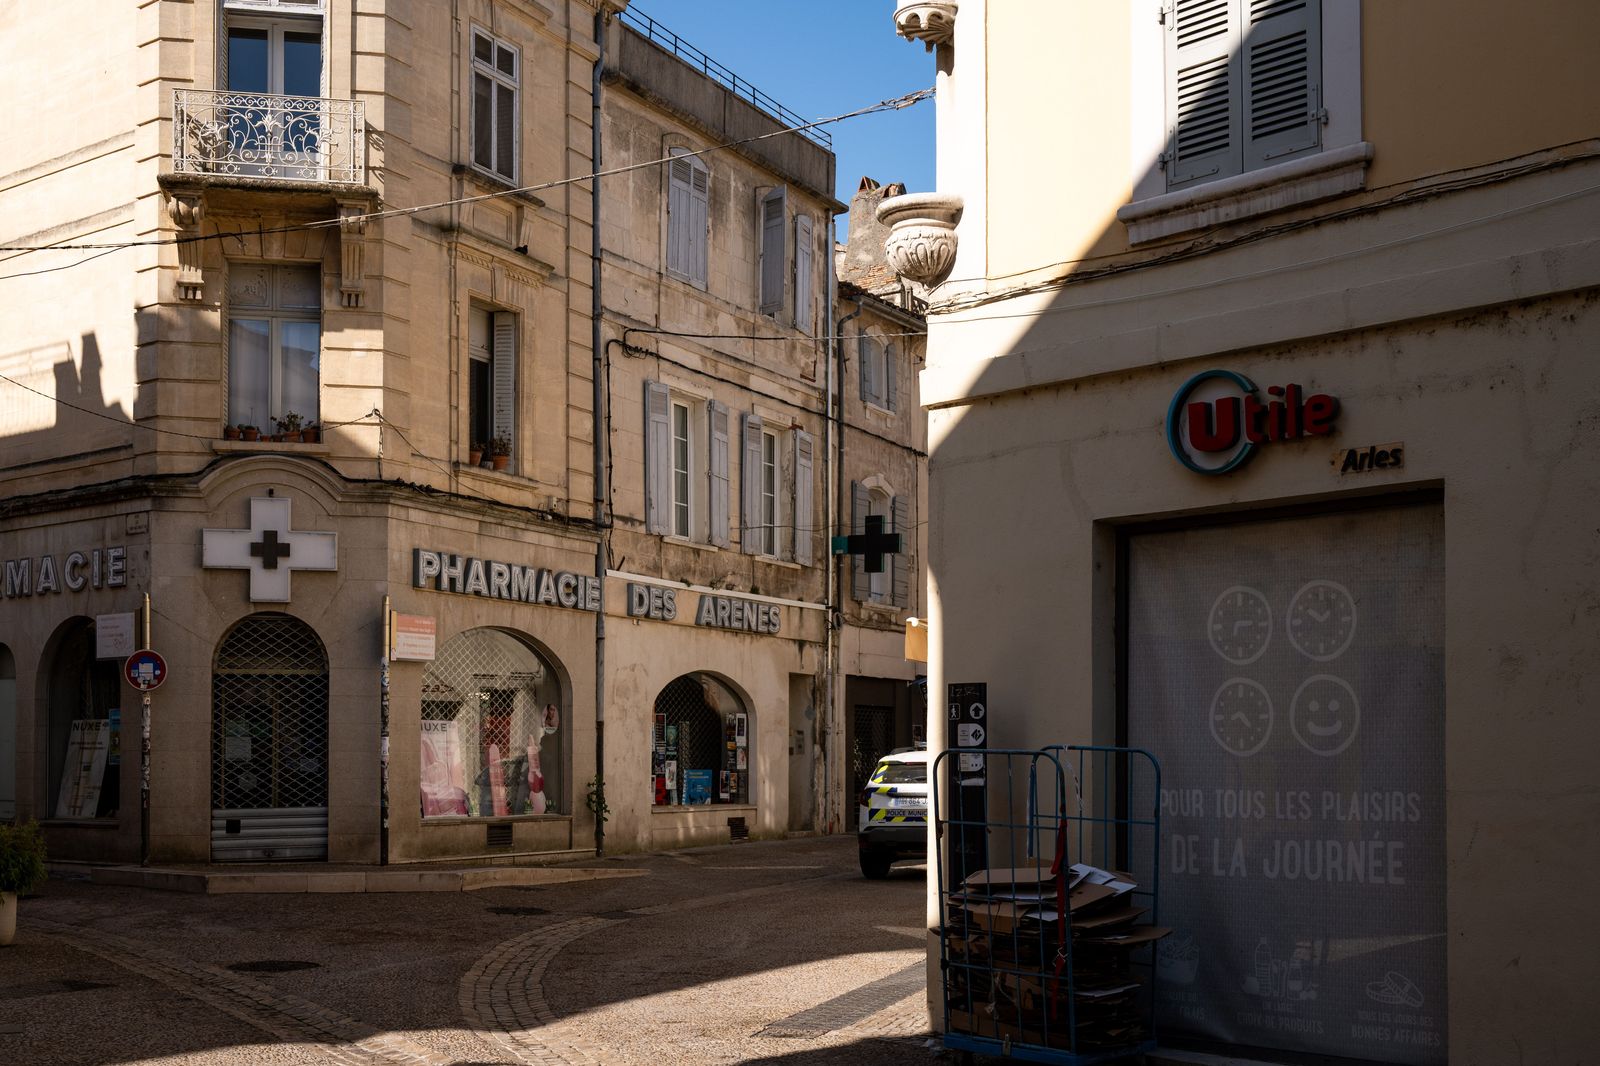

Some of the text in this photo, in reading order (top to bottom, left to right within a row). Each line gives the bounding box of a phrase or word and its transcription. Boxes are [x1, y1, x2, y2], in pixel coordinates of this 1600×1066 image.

[1187, 383, 1341, 452] Utile
[1341, 446, 1402, 472] Arles
[0, 546, 127, 598] MACIE
[413, 548, 781, 635] PHARMACIE DES ARENES
[72, 721, 102, 732] NUXE
[887, 809, 906, 817] POLICE
[1160, 788, 1421, 823] POUR TOUS LES PLAISIRS
[1171, 831, 1406, 885] DE LA JOURNÉE
[1278, 1016, 1325, 1034] PRODUITS
[1351, 1024, 1441, 1047] BONNES AFFAIRES
